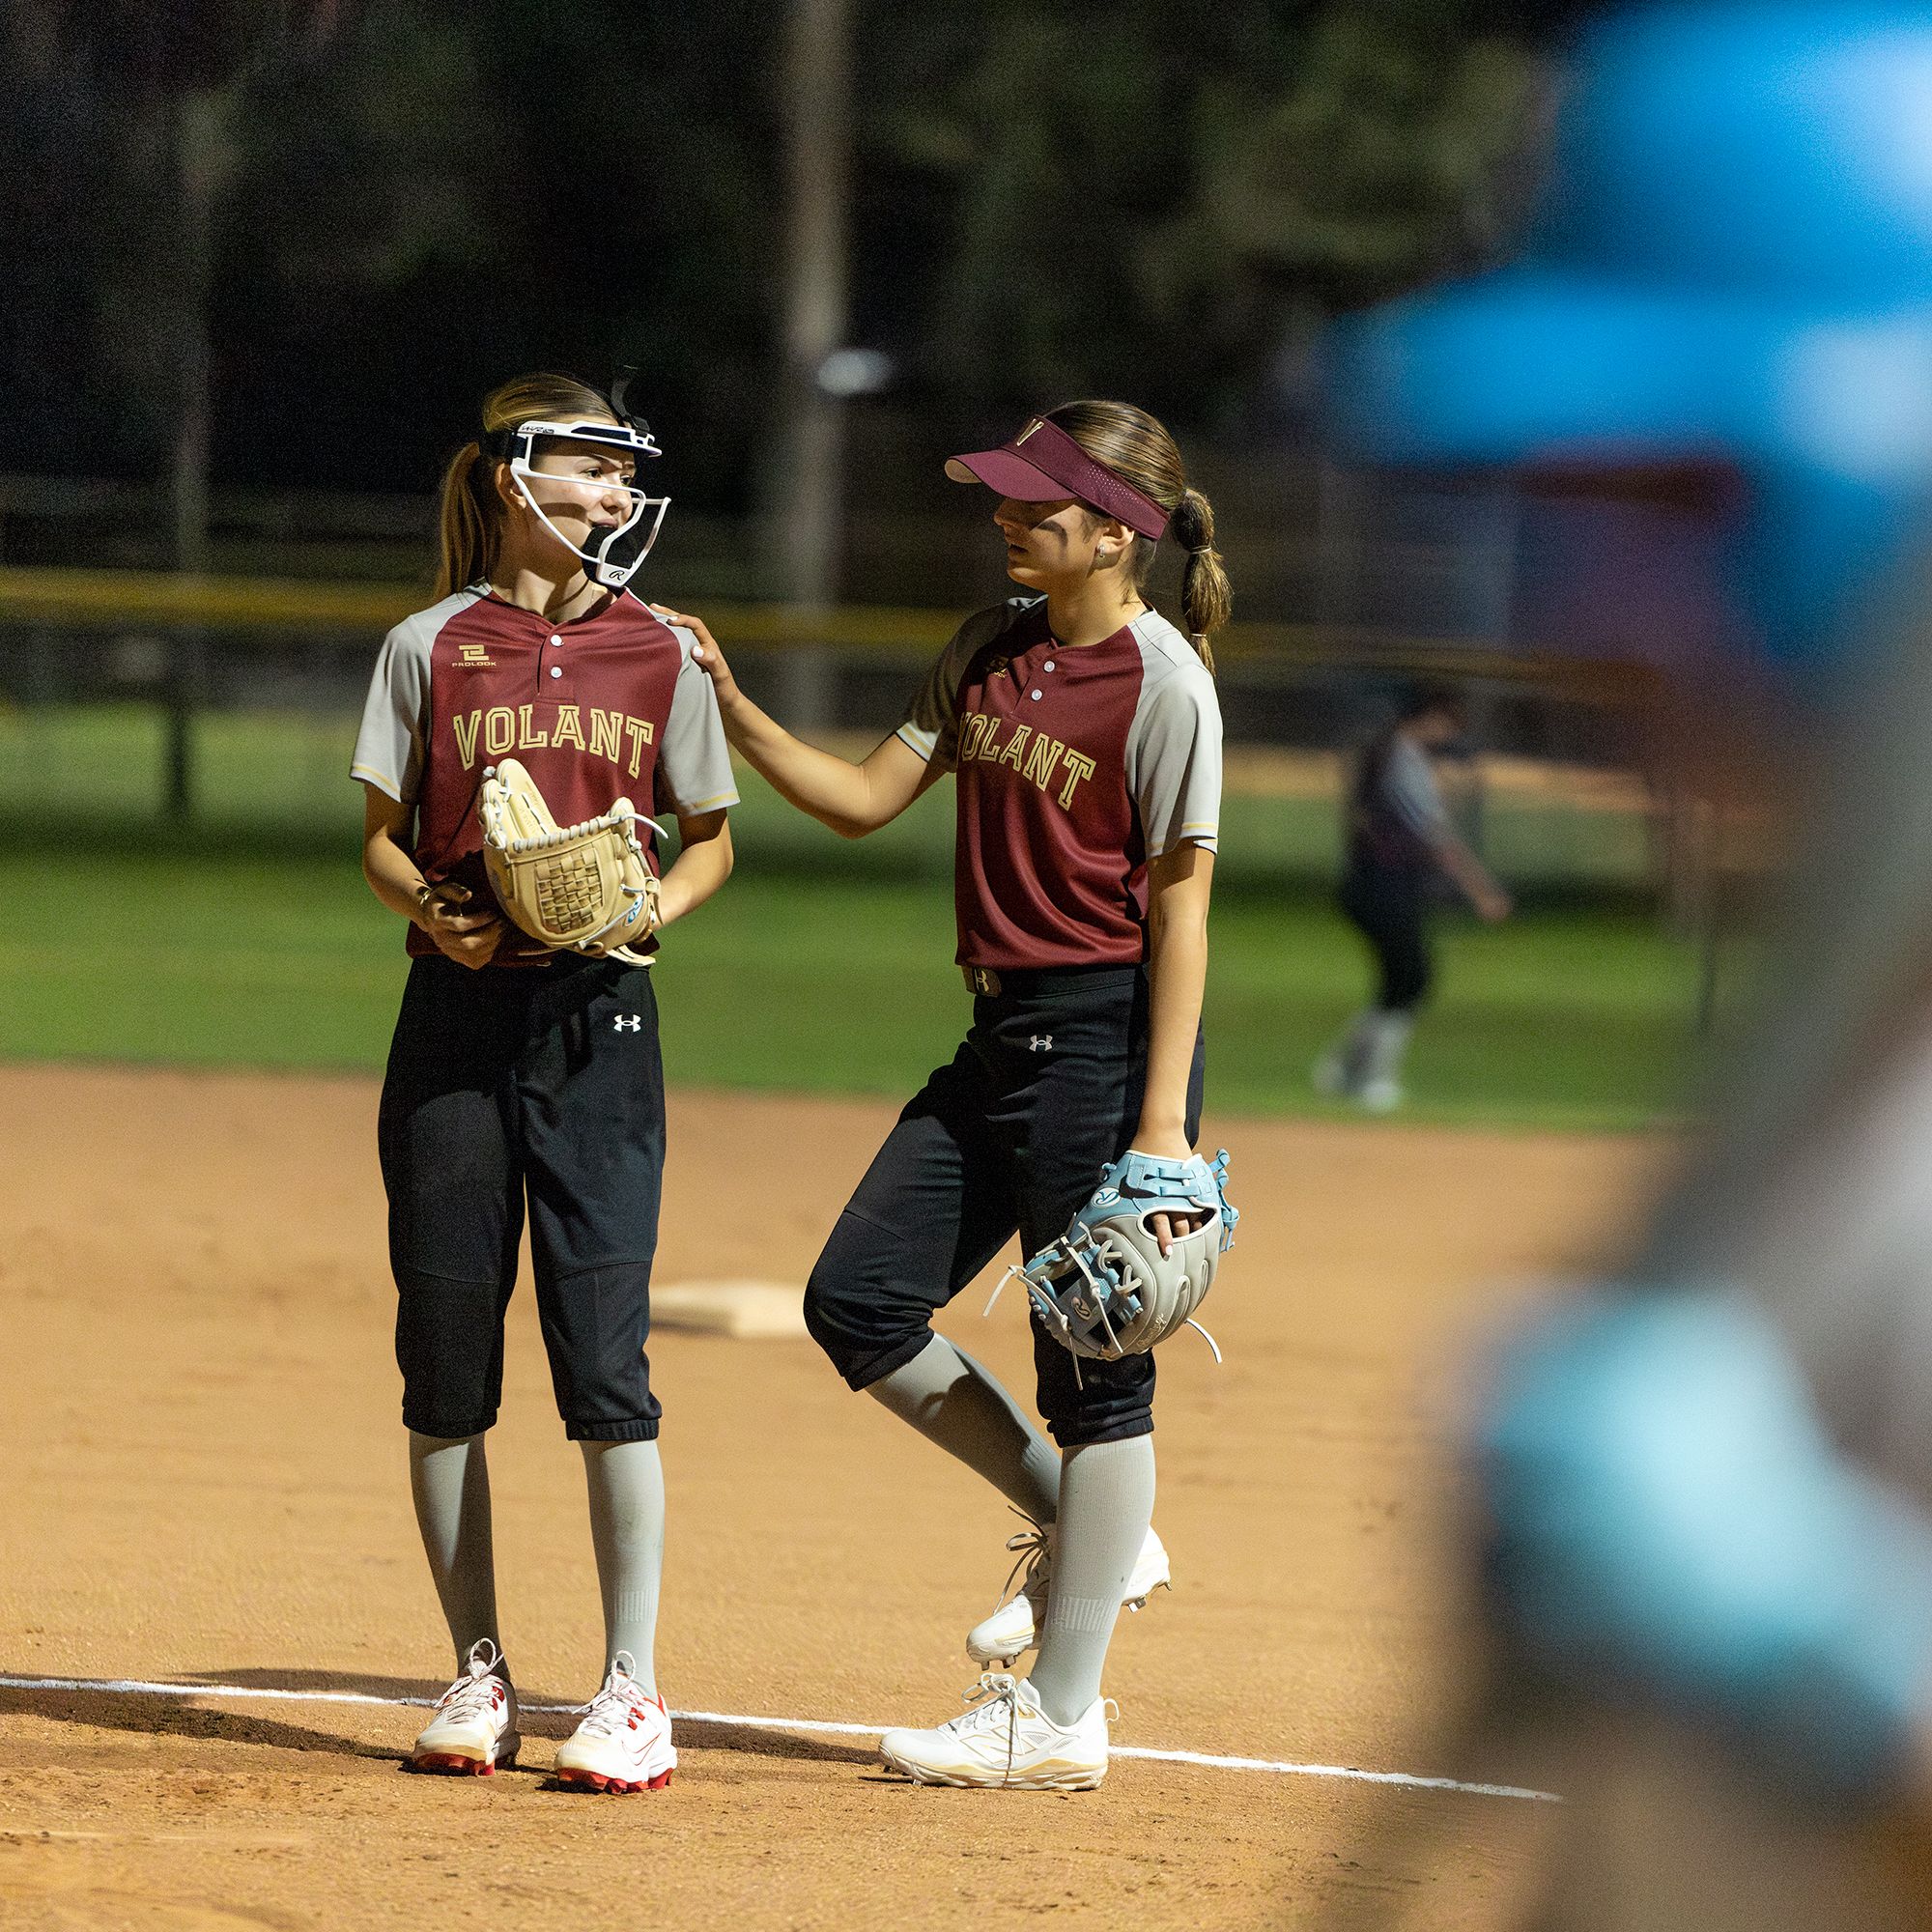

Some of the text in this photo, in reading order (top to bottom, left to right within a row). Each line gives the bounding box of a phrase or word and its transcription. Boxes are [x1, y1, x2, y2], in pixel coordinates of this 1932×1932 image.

[1017, 418, 1044, 446] V
[609, 569, 625, 582] R
[453, 704, 655, 780] VOLANT
